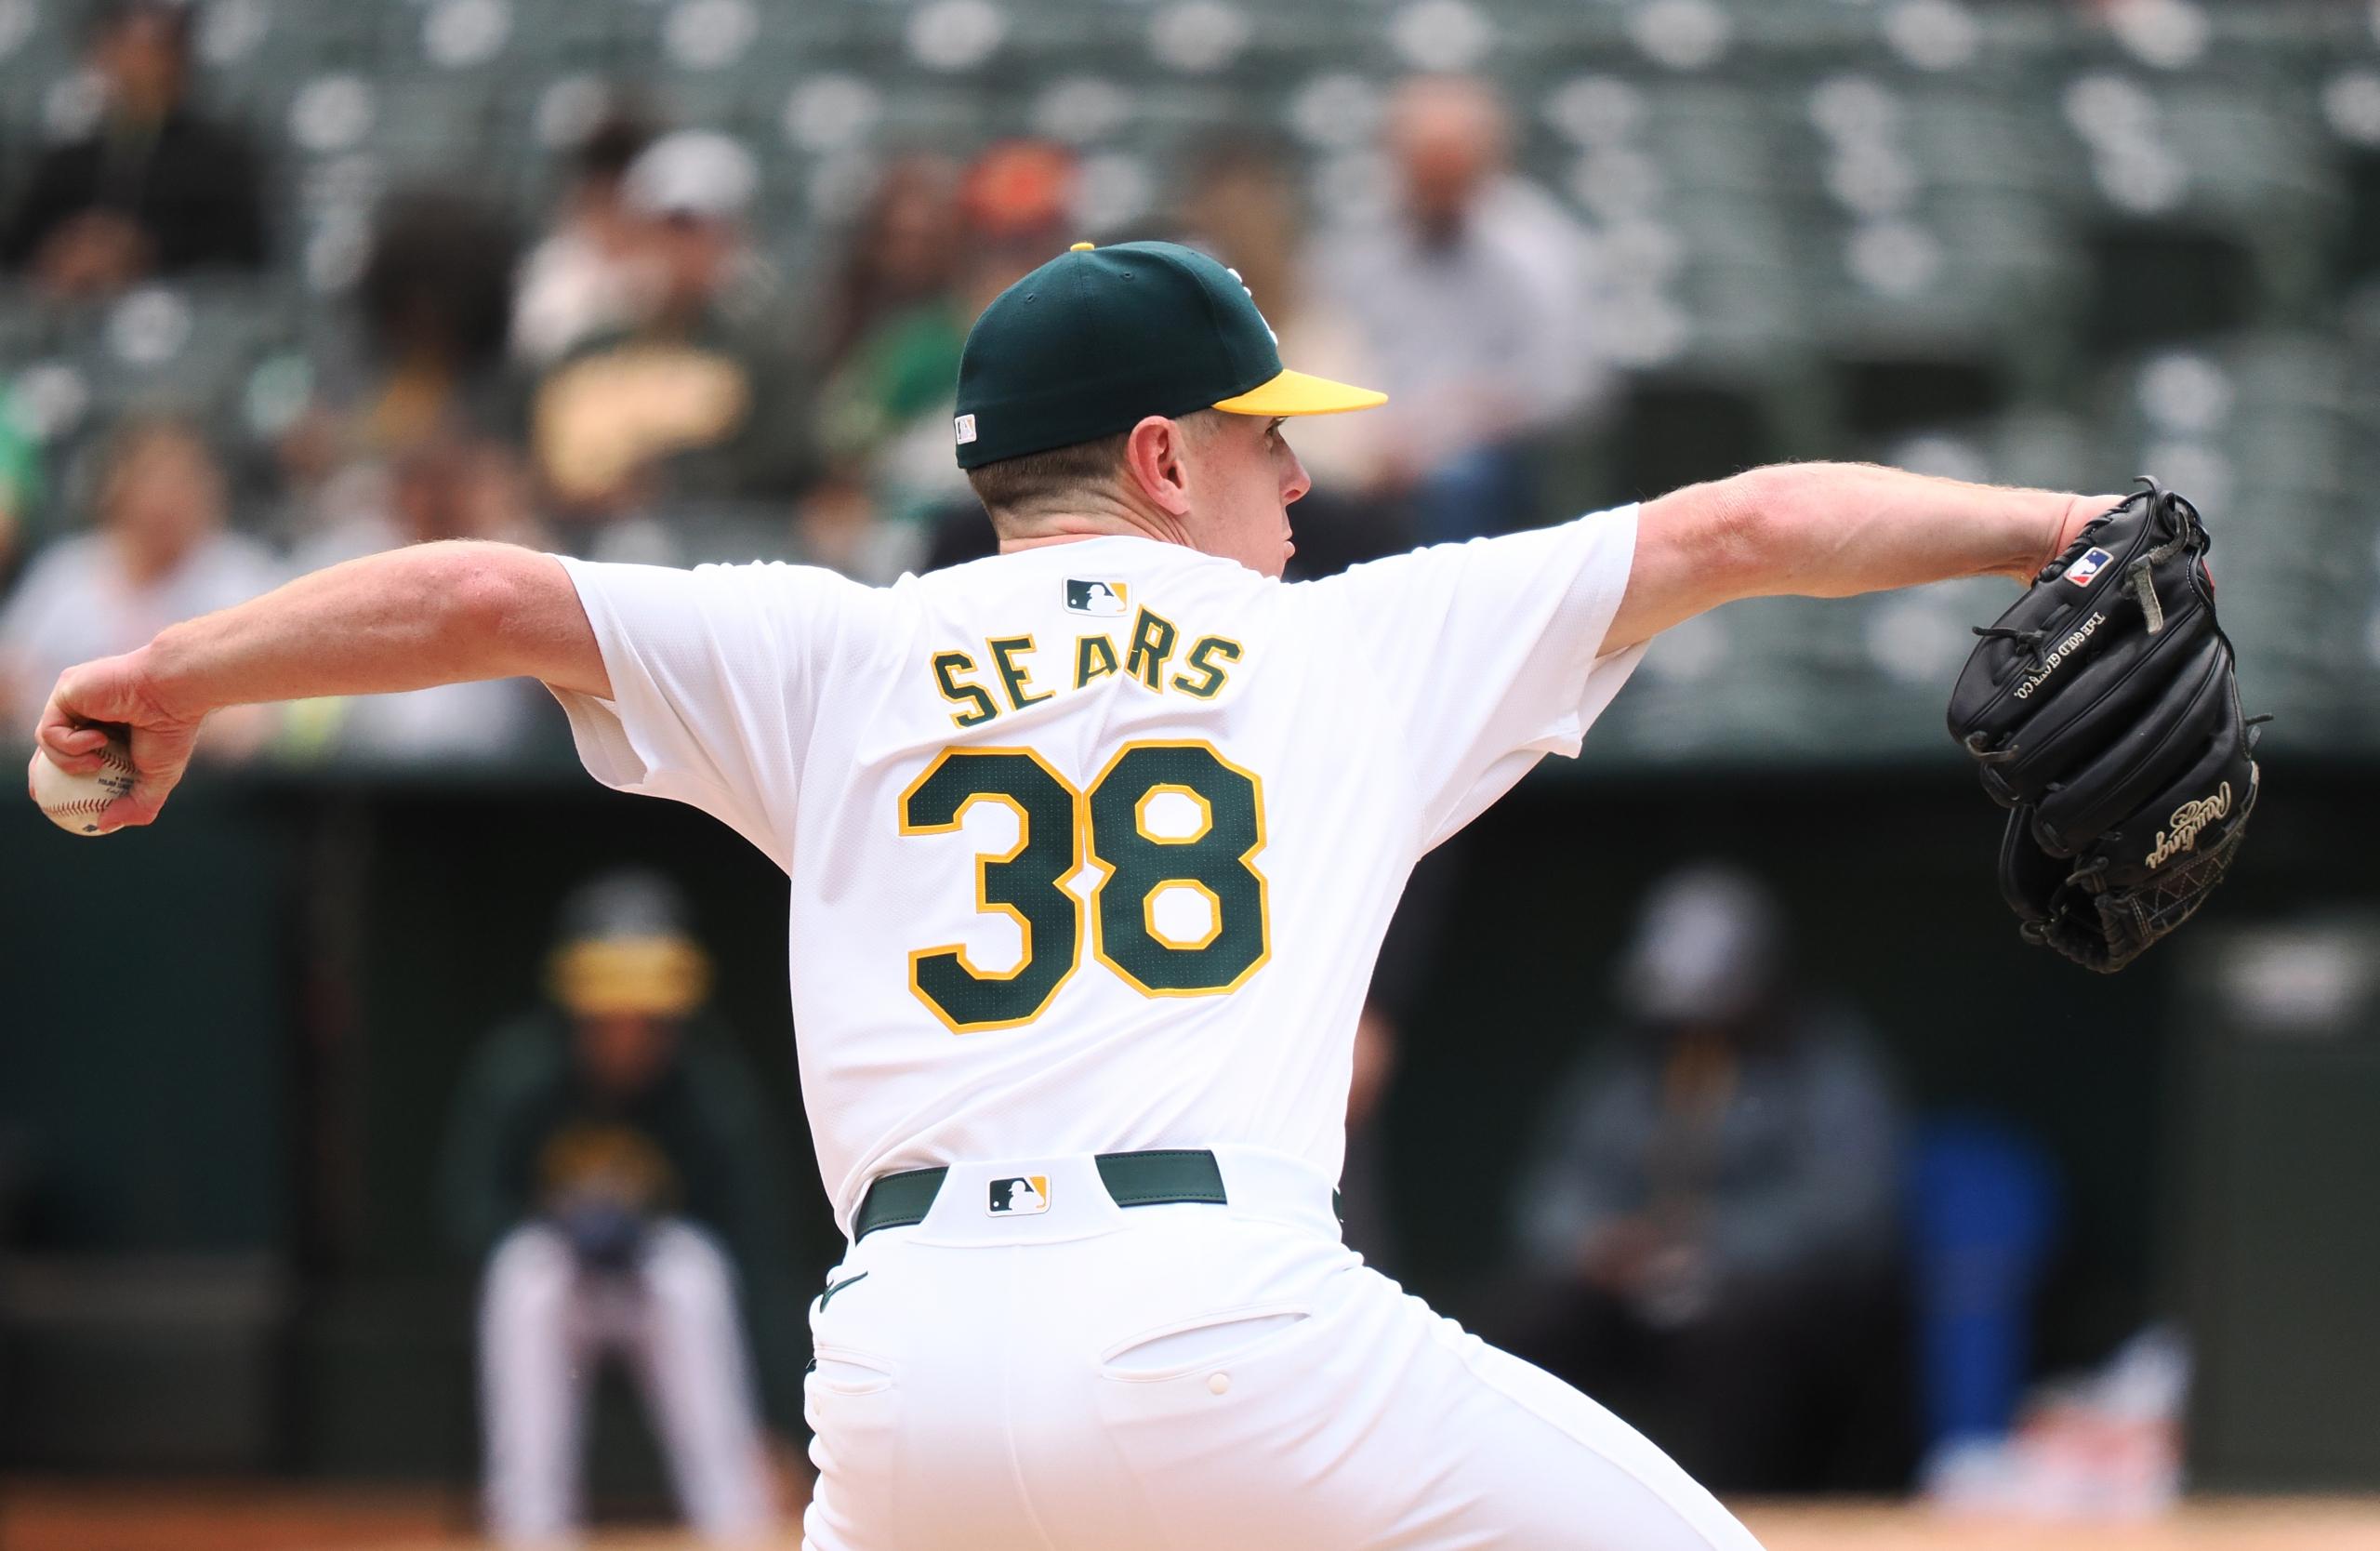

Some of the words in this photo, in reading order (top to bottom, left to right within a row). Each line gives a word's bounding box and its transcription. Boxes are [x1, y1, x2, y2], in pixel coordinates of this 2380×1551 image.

[2057, 631, 2085, 656] GOLD
[2080, 611, 2106, 636] THE
[932, 605, 1244, 728] SEARS
[2014, 682, 2034, 699] CO.
[2146, 781, 2231, 868] Rawlings
[899, 740, 1272, 1034] 38
